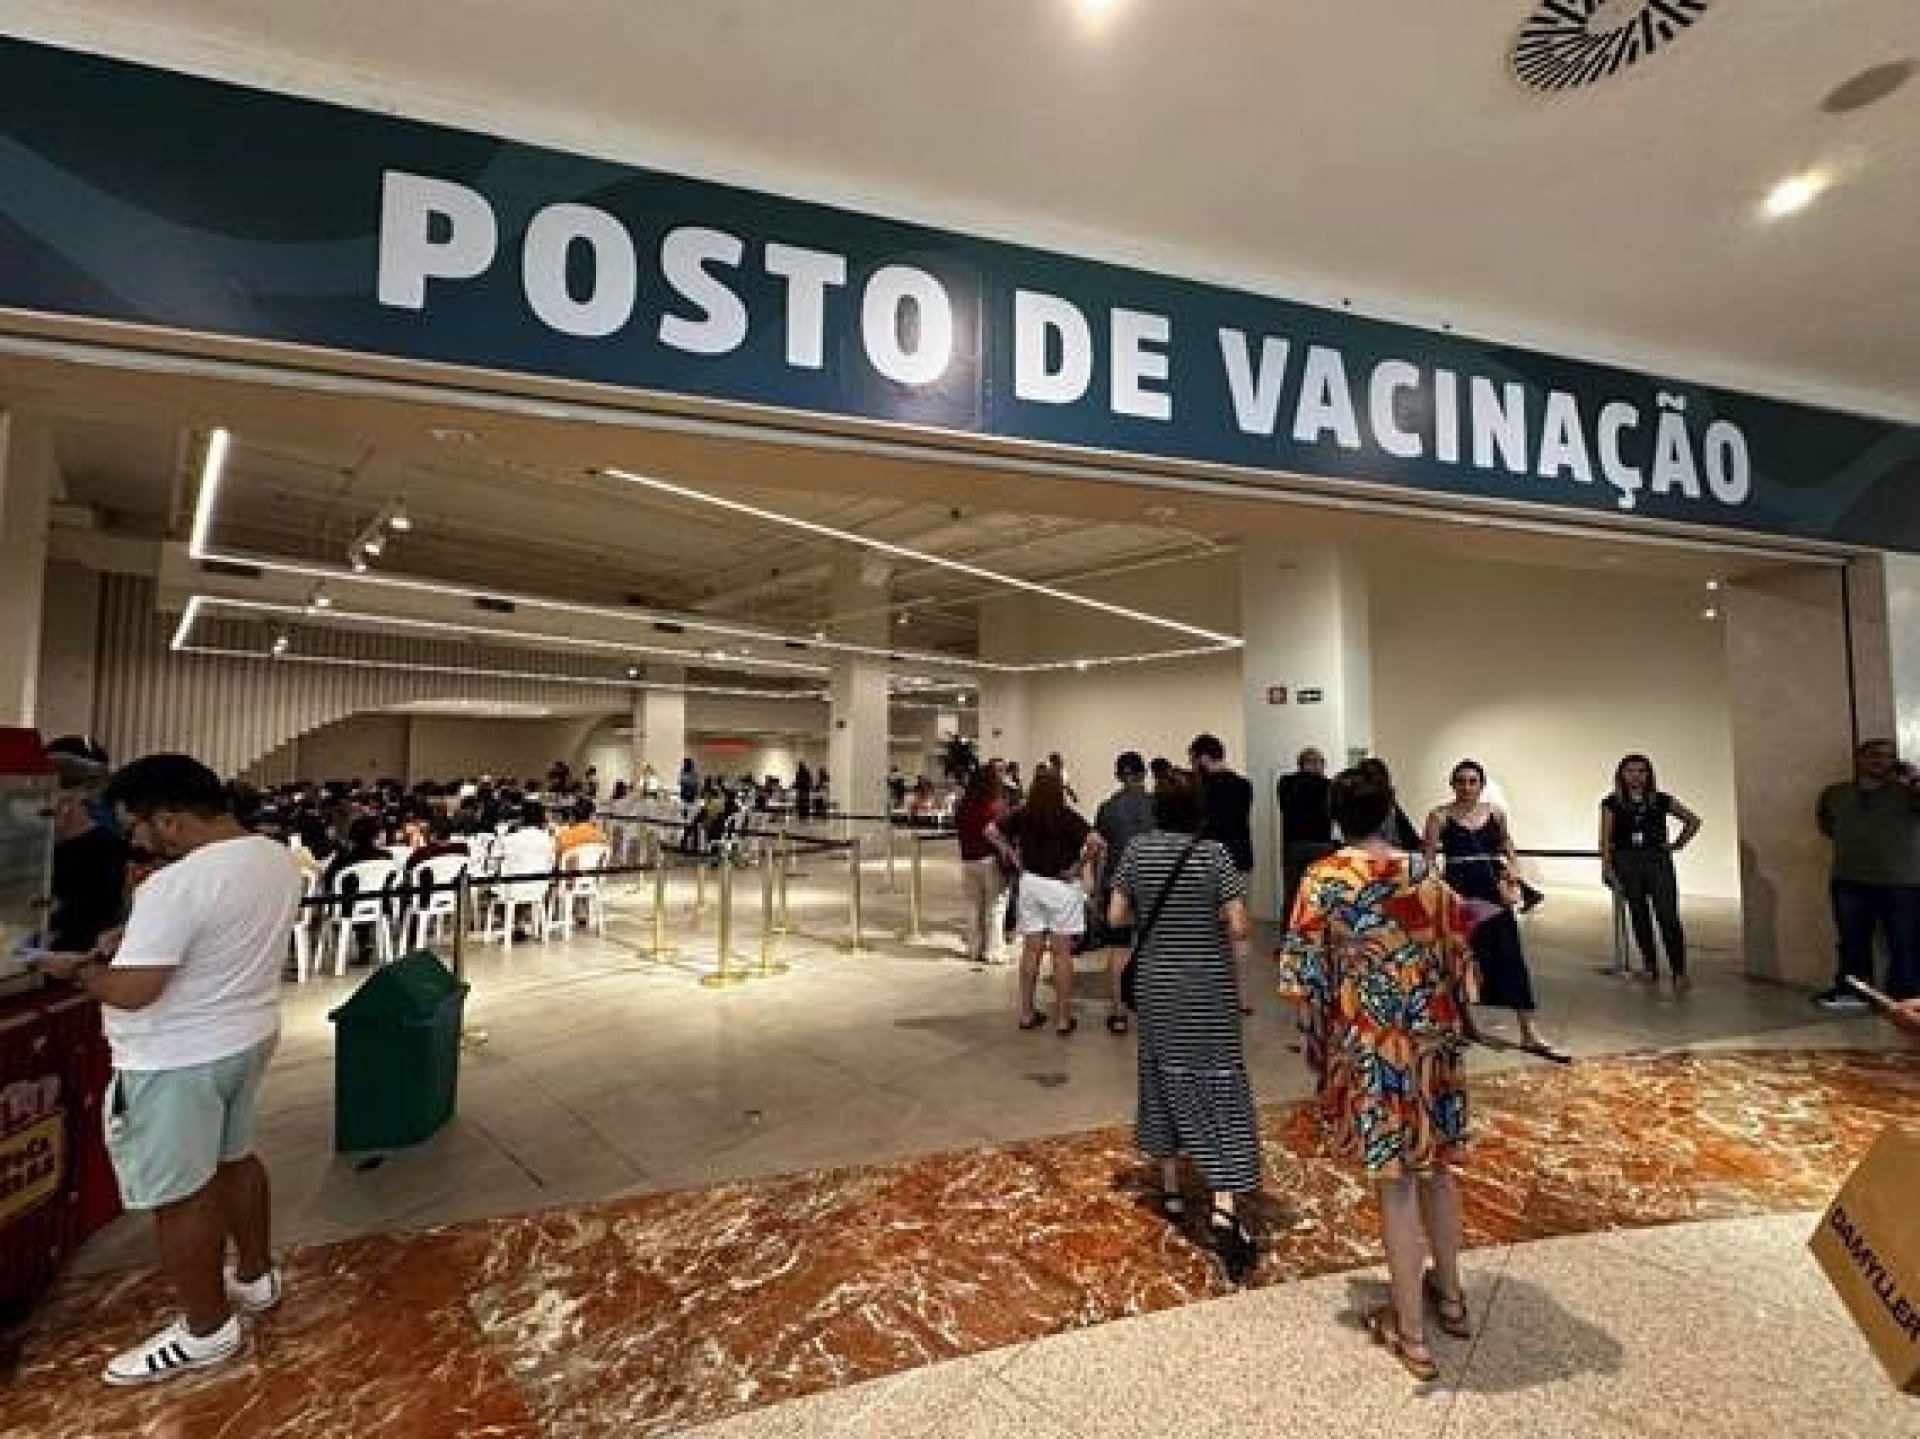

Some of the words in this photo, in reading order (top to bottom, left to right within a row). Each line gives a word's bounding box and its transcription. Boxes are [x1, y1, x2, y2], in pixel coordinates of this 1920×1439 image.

[379, 168, 953, 386] POSTO
[1014, 289, 1172, 421] DE
[1218, 327, 1751, 509] VACINAÇÃO
